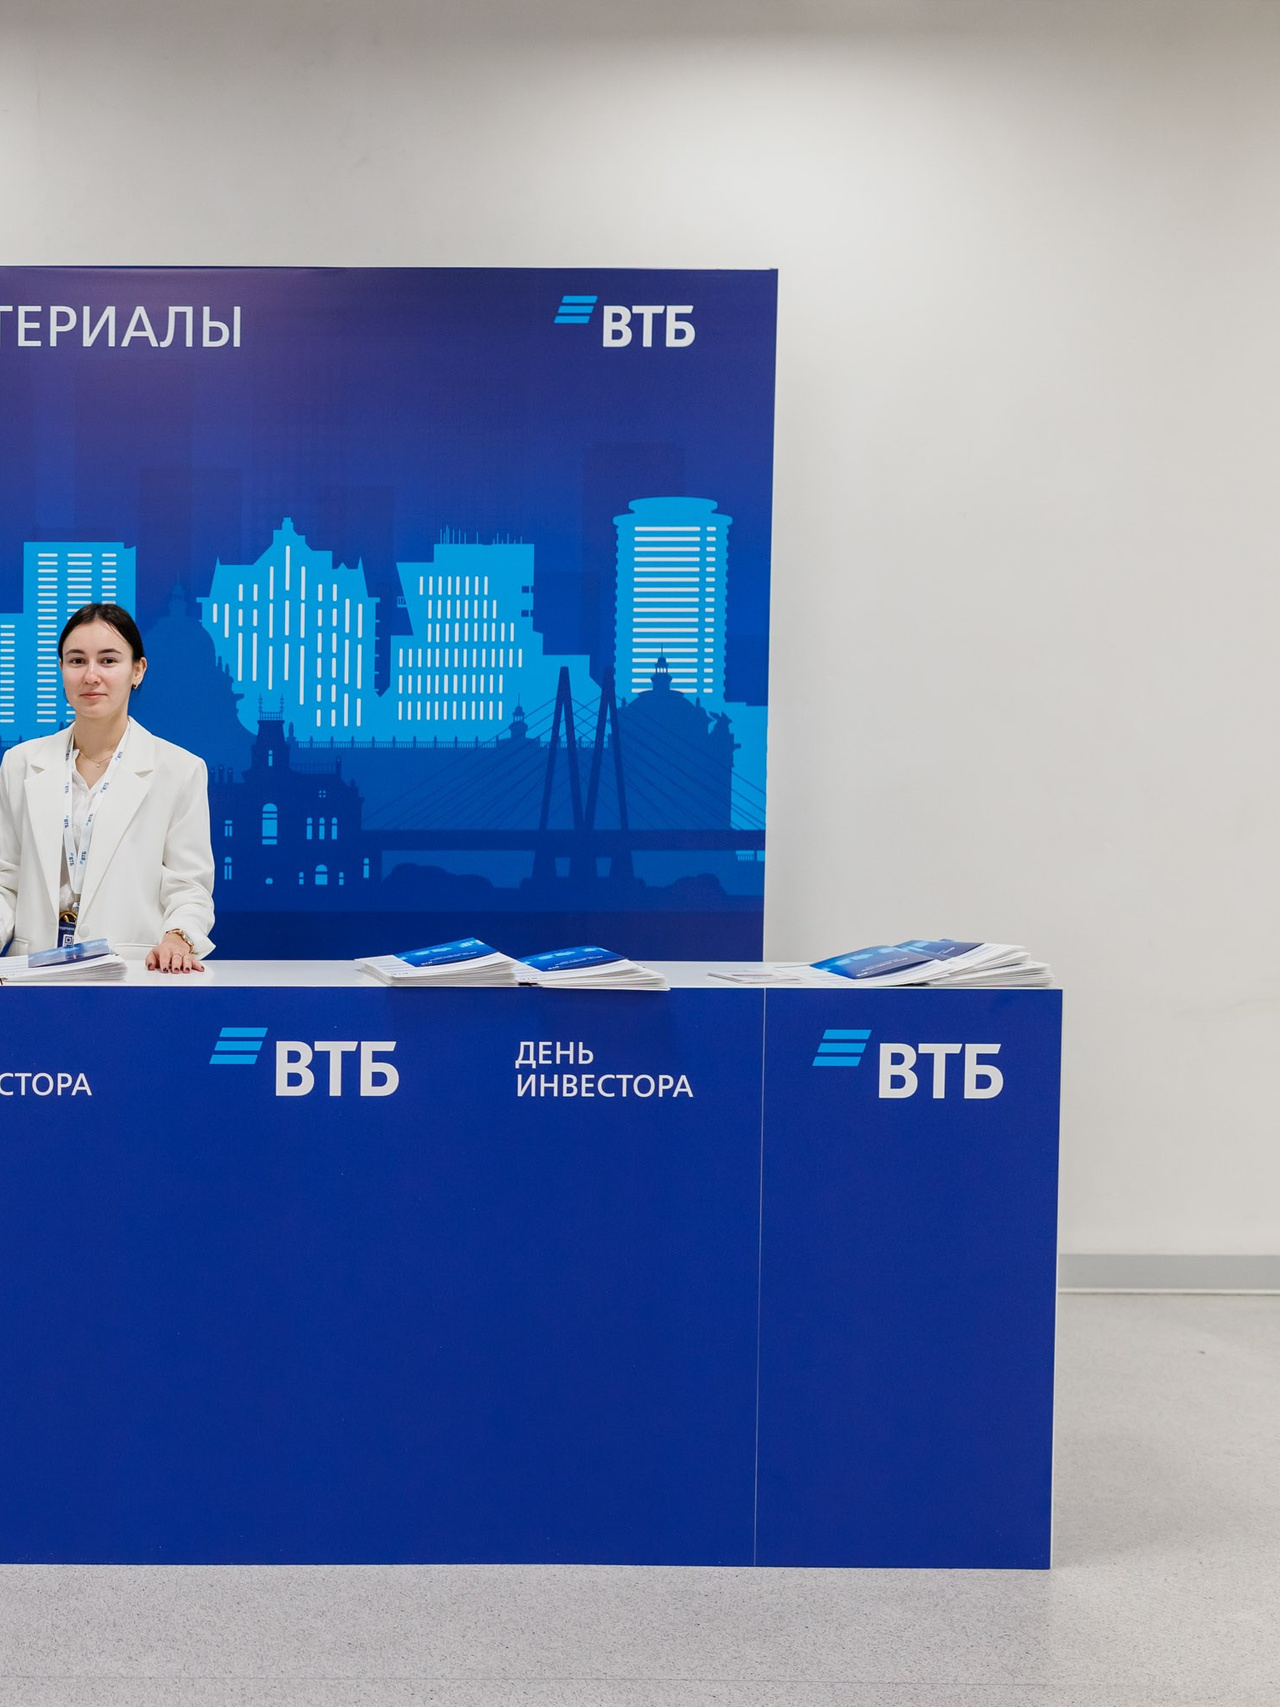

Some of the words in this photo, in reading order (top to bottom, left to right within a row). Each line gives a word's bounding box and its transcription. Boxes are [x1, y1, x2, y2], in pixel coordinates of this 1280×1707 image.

[602, 305, 696, 348] ВТБ
[275, 1040, 400, 1097] ВТБ
[515, 1041, 594, 1069] ДЕНЬ
[878, 1042, 1004, 1100] ВТБ
[517, 1074, 694, 1098] ИНВЕСТОРА
